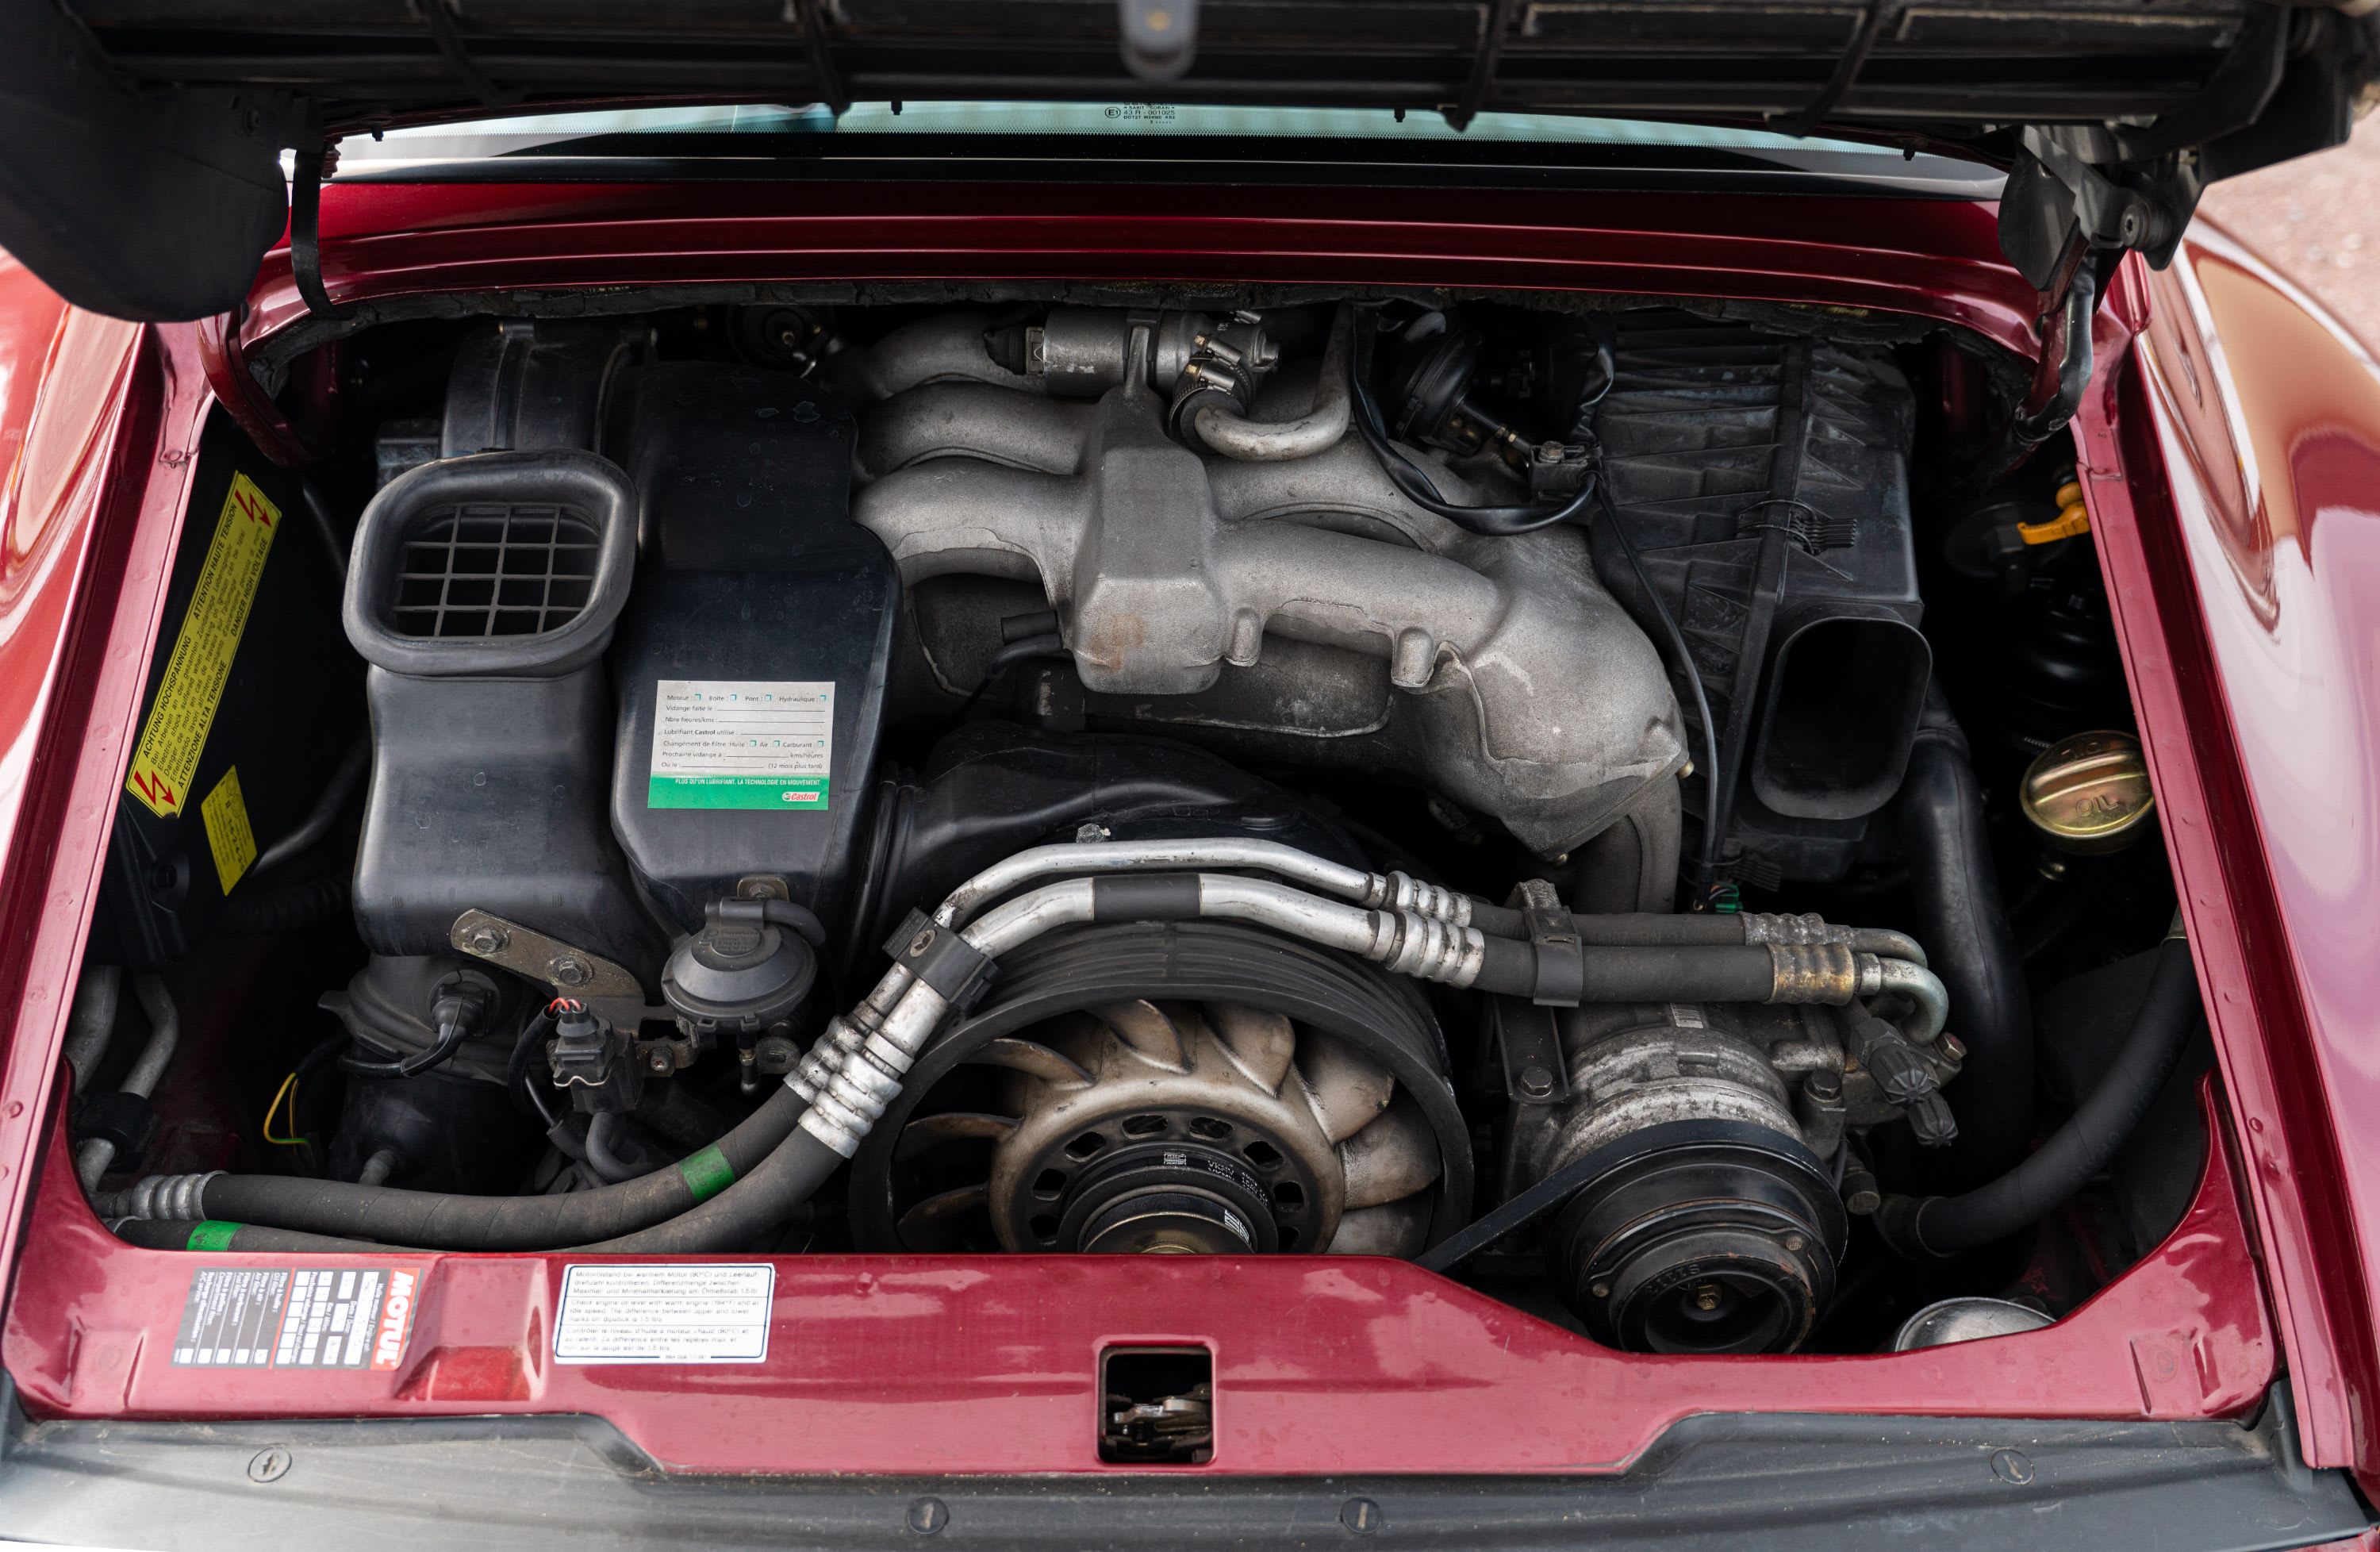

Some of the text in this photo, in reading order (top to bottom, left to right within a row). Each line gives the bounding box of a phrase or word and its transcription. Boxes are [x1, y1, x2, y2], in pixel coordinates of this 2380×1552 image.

[191, 501, 238, 620] ATTENTION HAUTE TENSION
[229, 536, 269, 638] DANGER HIGH VOLTAGE
[141, 633, 191, 759] ACHTUNG HOCHSPANNUNG
[149, 748, 160, 766] Bei
[156, 711, 175, 748] Arbeiten
[175, 680, 185, 697] der
[182, 639, 201, 681] gesamten
[156, 738, 173, 772] Electric
[169, 711, 182, 738] shock
[178, 675, 195, 711] suffered
[191, 651, 204, 675] when
[200, 619, 216, 652] working
[215, 575, 231, 607] ignition
[226, 560, 236, 577] can
[163, 744, 180, 778] Danger
[180, 708, 192, 730] mort
[194, 678, 203, 694] cas
[204, 632, 219, 663] travaux
[215, 616, 225, 632] sur
[176, 659, 227, 789] ATTENZIONE ALTA TENSIONE
[187, 709, 200, 734] lavori
[209, 637, 225, 673] impianto
[2075, 794, 2120, 817] OIL
[375, 1271, 414, 1365] MOTUL
